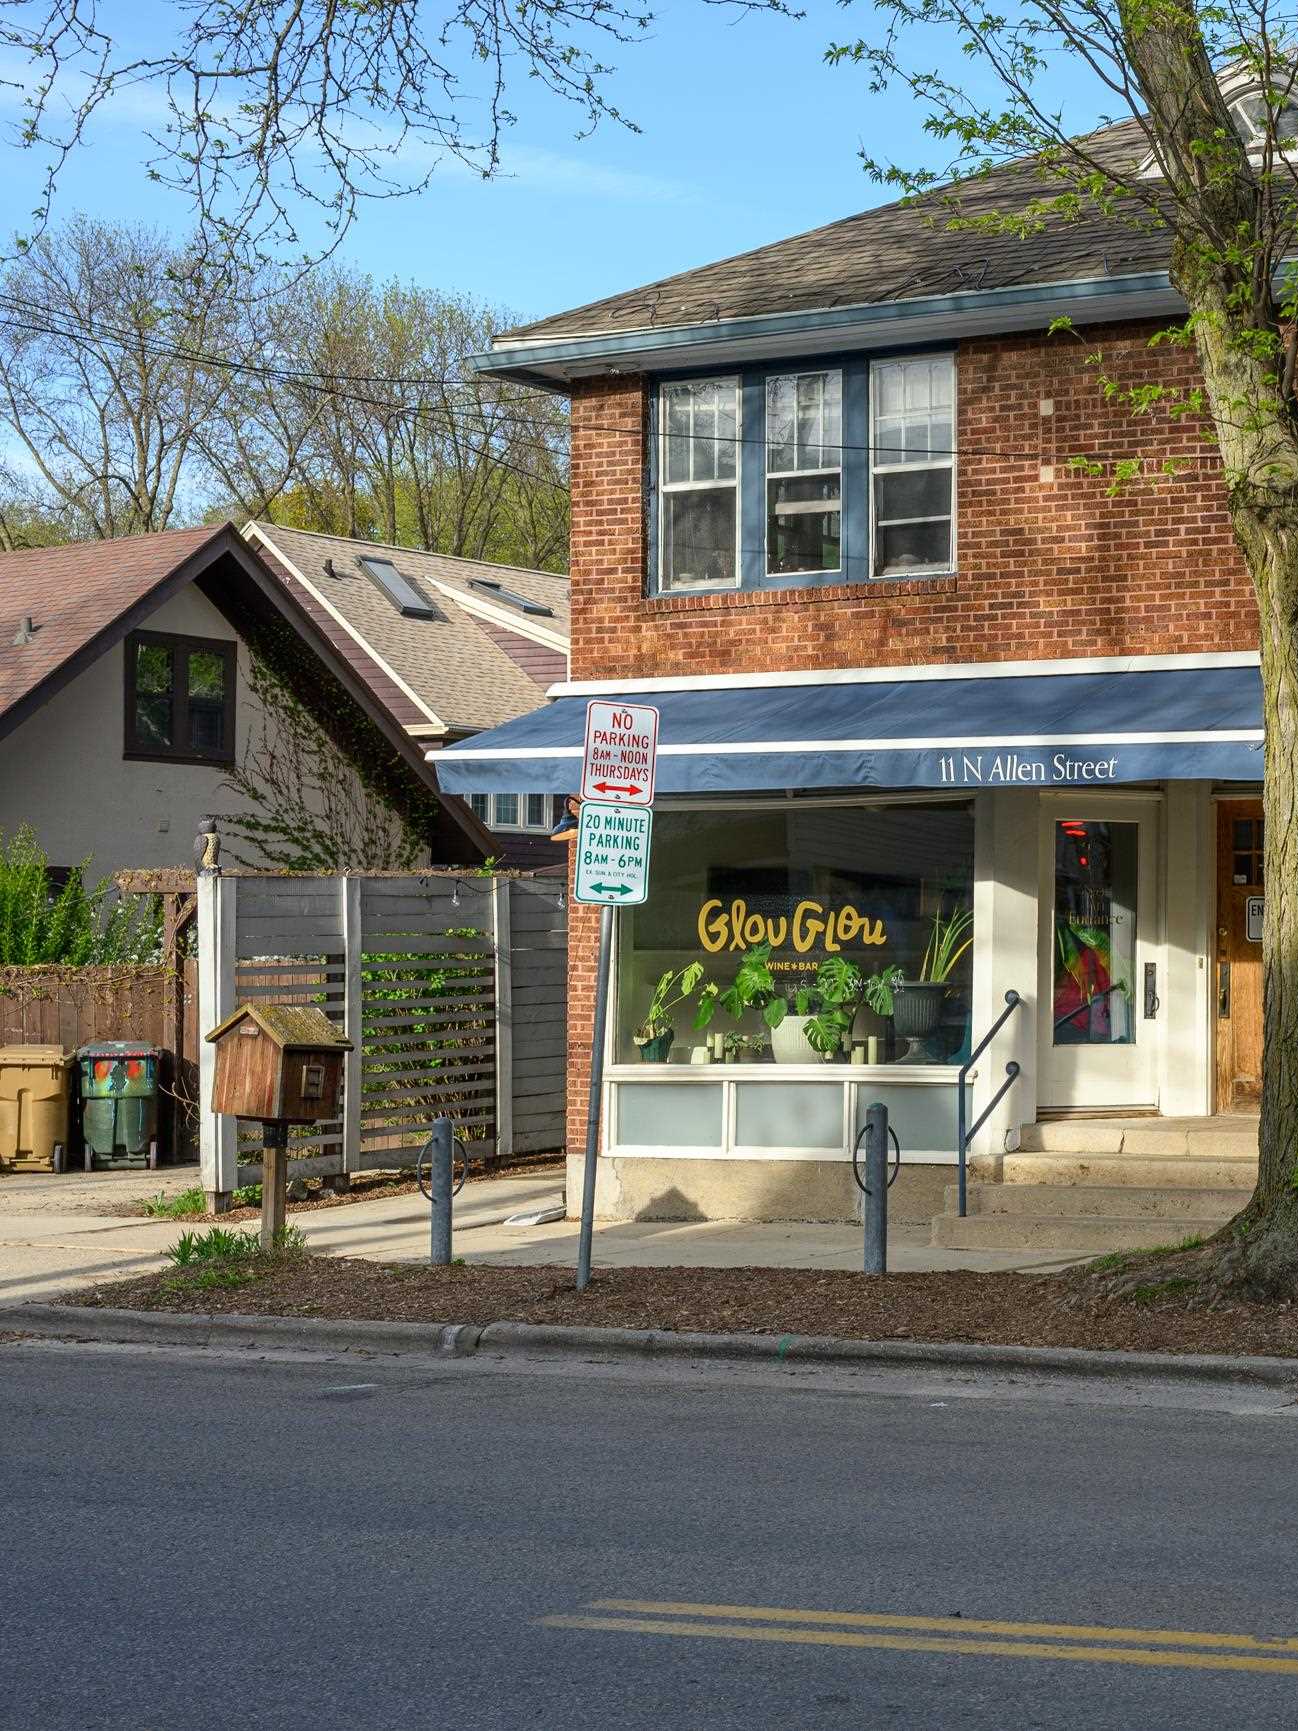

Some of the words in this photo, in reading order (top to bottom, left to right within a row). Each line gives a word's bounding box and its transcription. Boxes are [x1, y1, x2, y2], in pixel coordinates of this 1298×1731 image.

[612, 712, 633, 730] NO
[593, 730, 649, 749] PARKING
[592, 747, 611, 761] 8AM
[620, 750, 648, 765] NOON
[589, 763, 649, 782] THURSDAYS
[939, 755, 955, 782] 11
[963, 755, 983, 782] N
[988, 755, 1046, 782] Allen
[1053, 753, 1119, 781] Street
[586, 814, 599, 830] 20
[604, 816, 645, 833] MINUTE
[589, 832, 640, 851] PARKING
[584, 851, 608, 865] 8AM
[618, 853, 642, 868] 6PM
[697, 899, 788, 952] Glou
